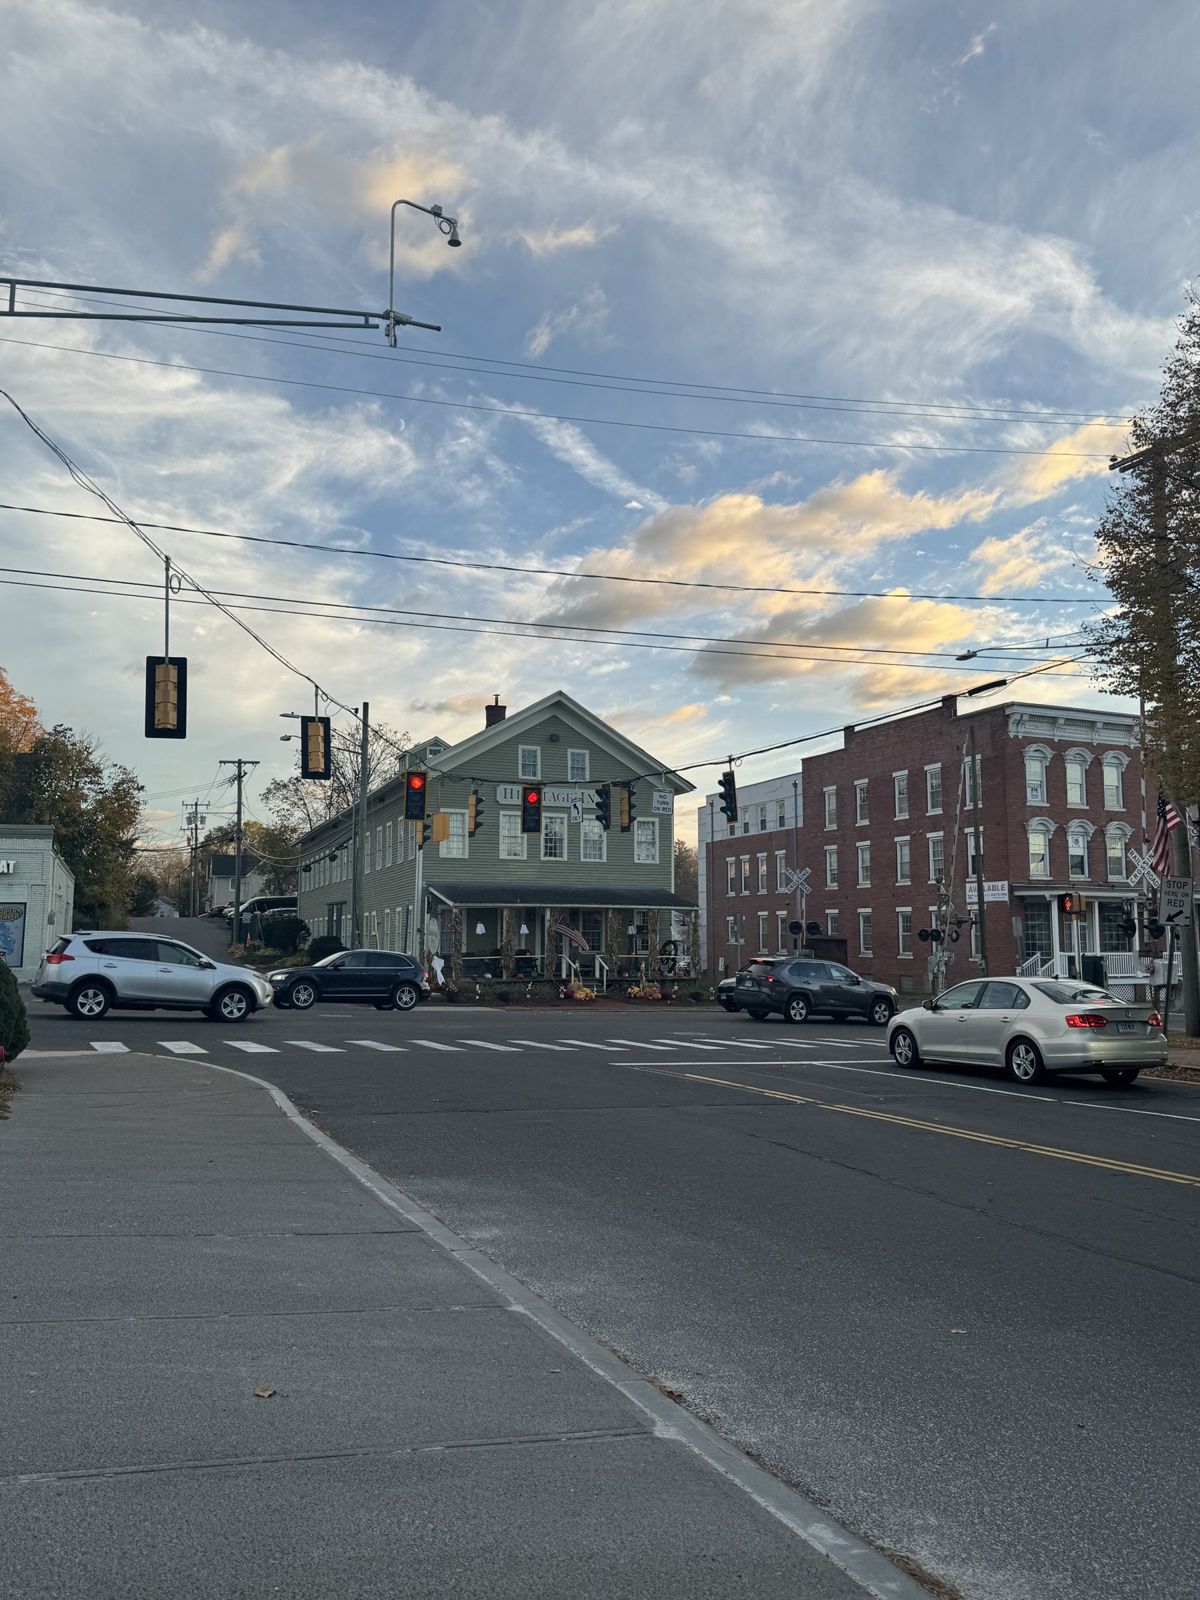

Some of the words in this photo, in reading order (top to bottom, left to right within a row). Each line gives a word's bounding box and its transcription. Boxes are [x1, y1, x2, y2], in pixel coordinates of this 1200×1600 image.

[1130, 851, 1155, 884] CROSSIN
[968, 884, 1006, 893] AVABLE
[1166, 880, 1189, 890] STOP
[1164, 890, 1178, 898] HERE
[1167, 898, 1184, 908] RED
